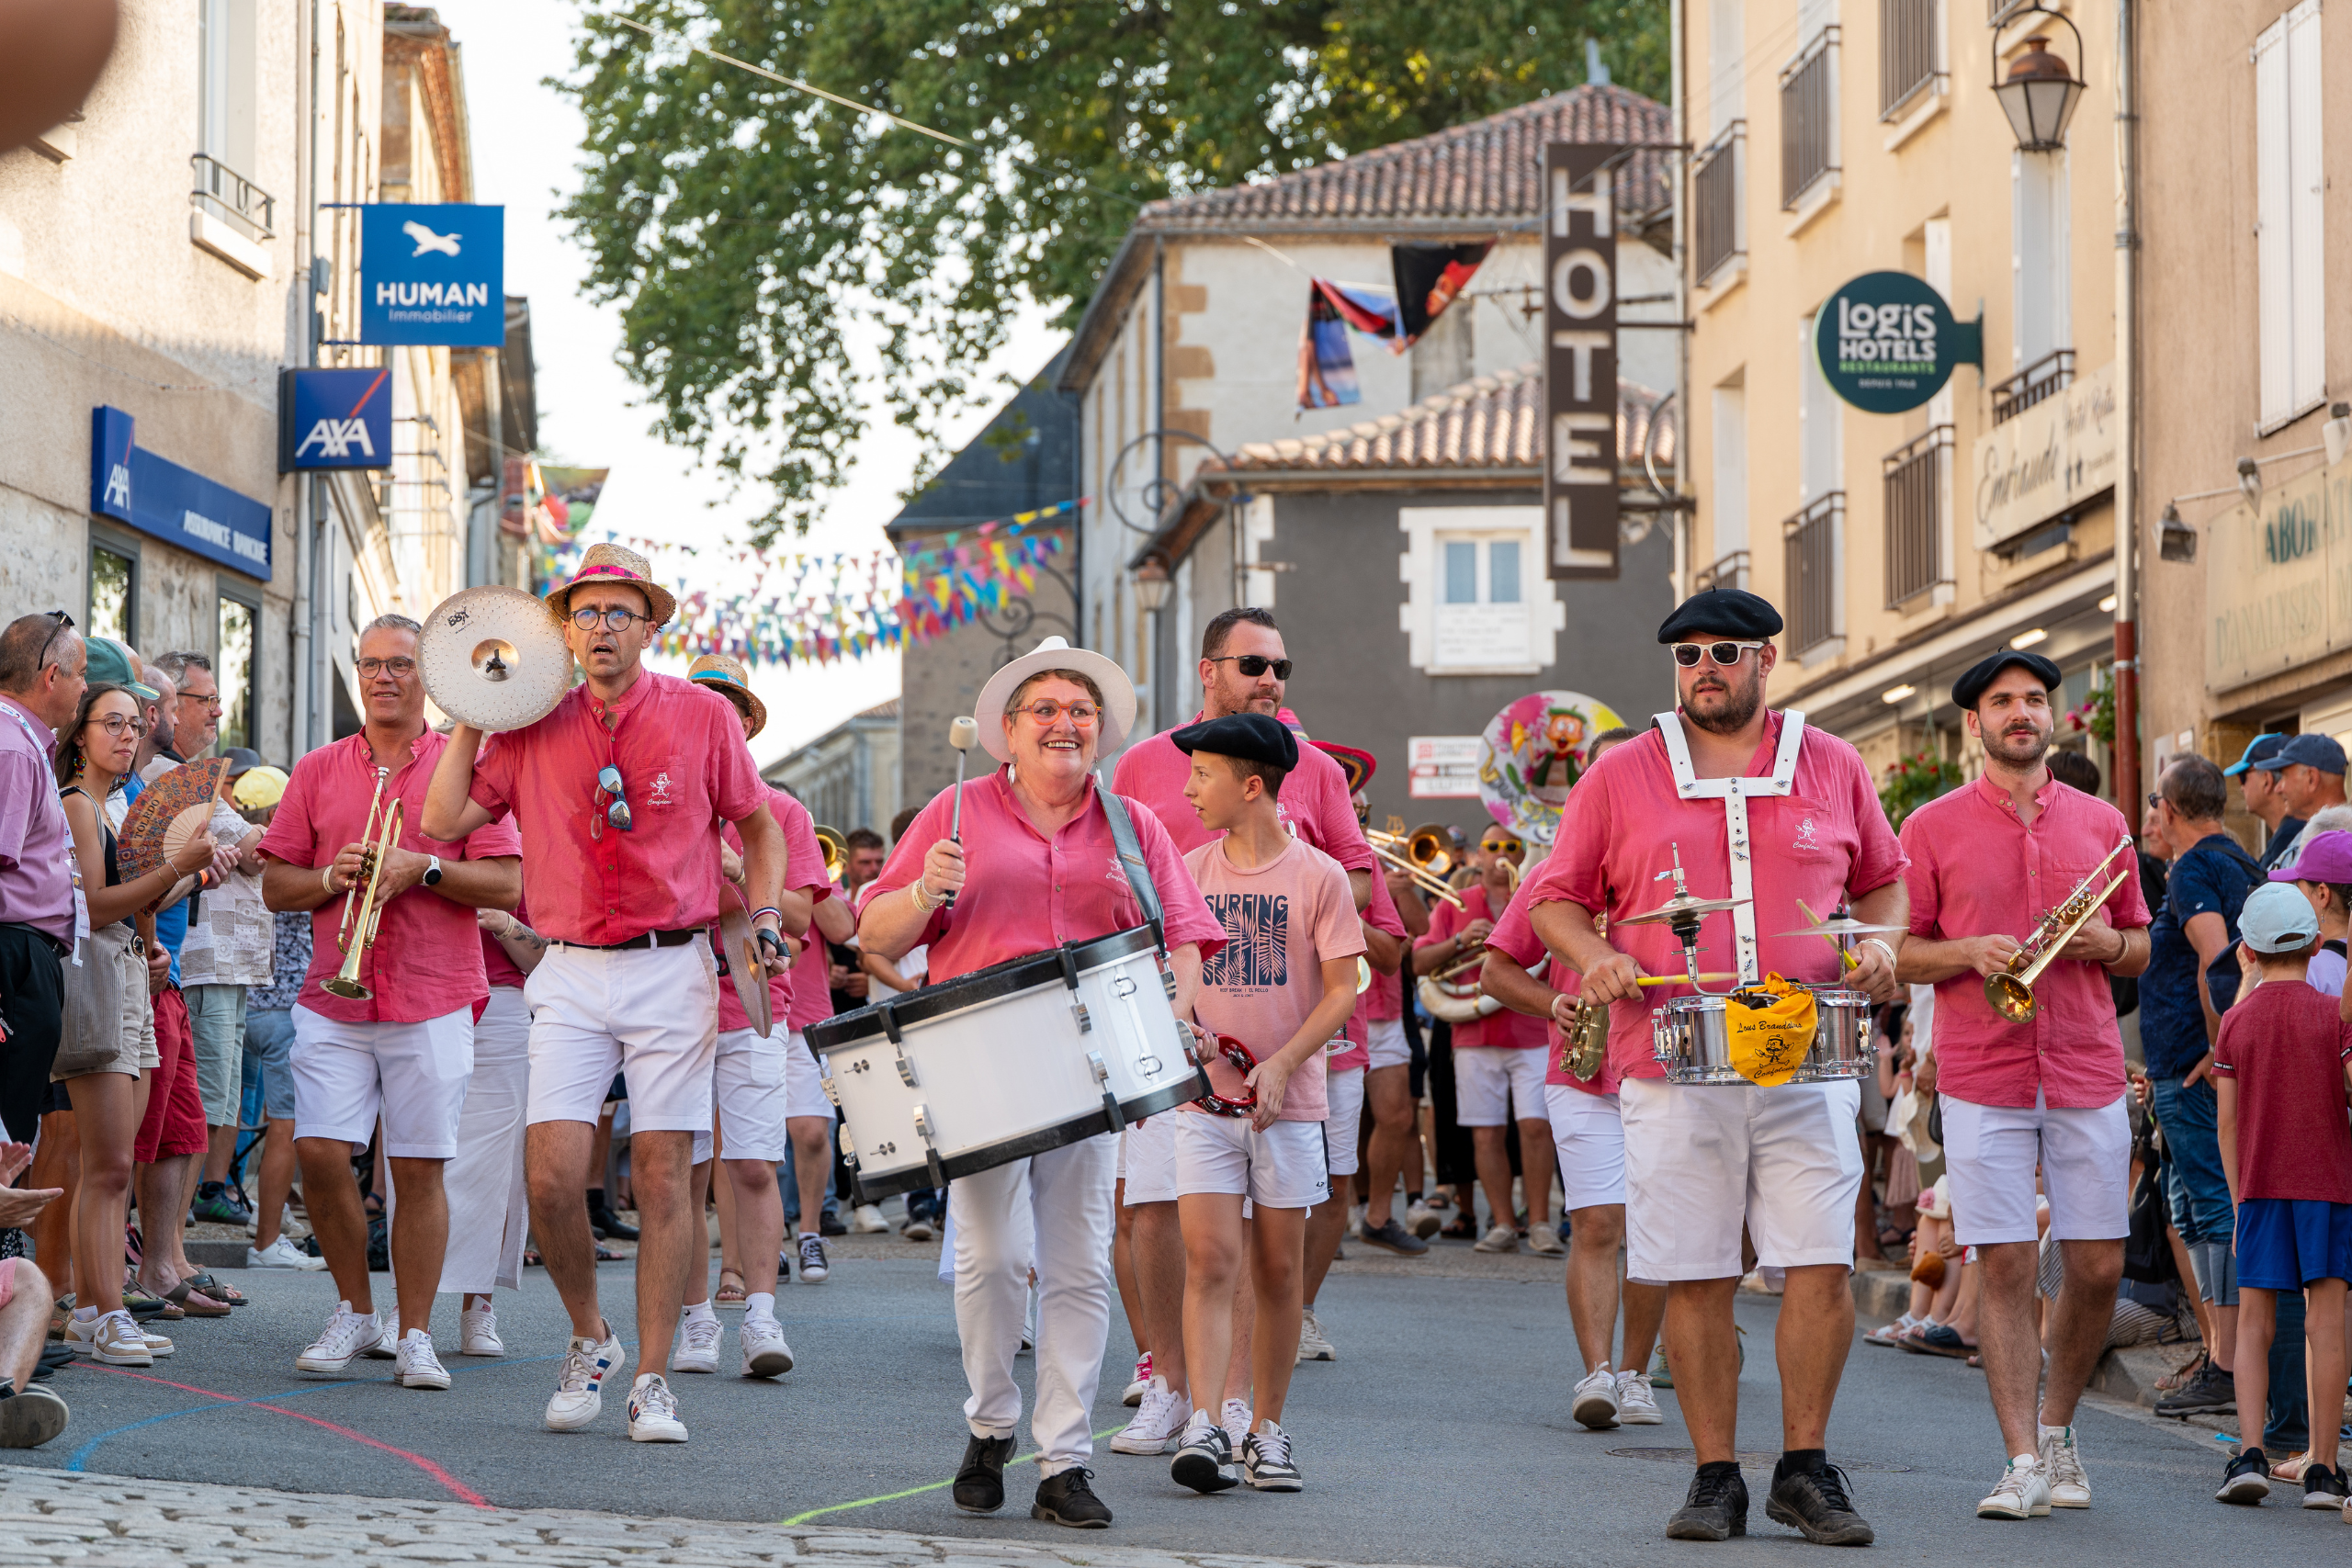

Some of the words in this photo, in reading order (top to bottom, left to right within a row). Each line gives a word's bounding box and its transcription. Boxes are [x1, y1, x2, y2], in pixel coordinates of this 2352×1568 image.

[376, 281, 489, 308] HUMAN
[388, 308, 474, 323] Immobilier
[1838, 339, 1938, 362] HOTELS
[1551, 168, 1612, 567] HOTEL
[1838, 360, 1937, 375] RESTAURANTS
[295, 417, 375, 458] AXA
[103, 462, 131, 512] AXA
[134, 799, 160, 839] TOLEDO
[1736, 1022, 1757, 1033] Lous
[1753, 1066, 1795, 1079] Confolens
